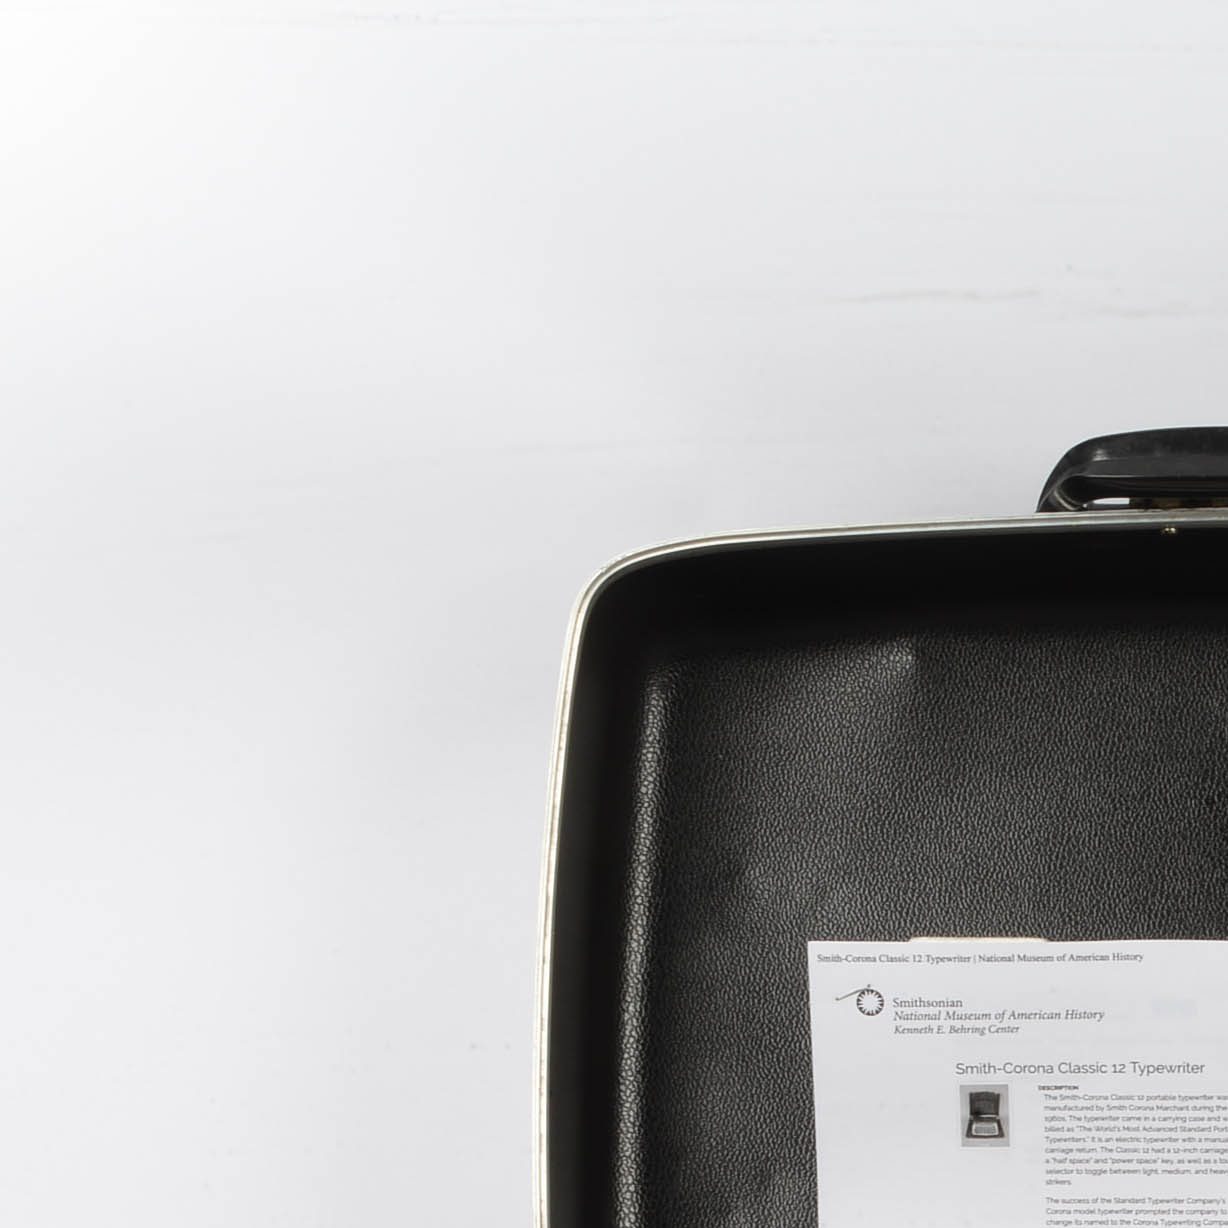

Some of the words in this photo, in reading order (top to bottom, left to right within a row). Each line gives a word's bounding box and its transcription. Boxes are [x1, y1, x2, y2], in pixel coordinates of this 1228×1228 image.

[816, 954, 878, 963] Smith-Corona
[878, 953, 910, 963] Classic
[912, 954, 923, 963] 12
[924, 955, 972, 964] Typewriter
[977, 953, 1016, 963] National
[1016, 953, 1055, 963] Museum
[1055, 953, 1067, 962] of
[1067, 952, 1111, 962] American
[1111, 953, 1144, 962] History
[892, 997, 964, 1008] Smithsonian
[892, 1010, 942, 1021] National
[943, 1010, 992, 1021] Museum
[993, 1010, 1008, 1023] of
[1008, 1010, 1062, 1021] American
[1064, 1009, 1105, 1022] History
[893, 1024, 935, 1034] Kenneth
[935, 1025, 946, 1034] E.
[947, 1024, 987, 1036] Behring
[987, 1024, 1021, 1034] Center
[955, 1062, 1055, 1075] Smith-Corona
[1057, 1062, 1109, 1074] Classic
[1111, 1064, 1127, 1073] 12
[1128, 1061, 1206, 1076] Typewriter
